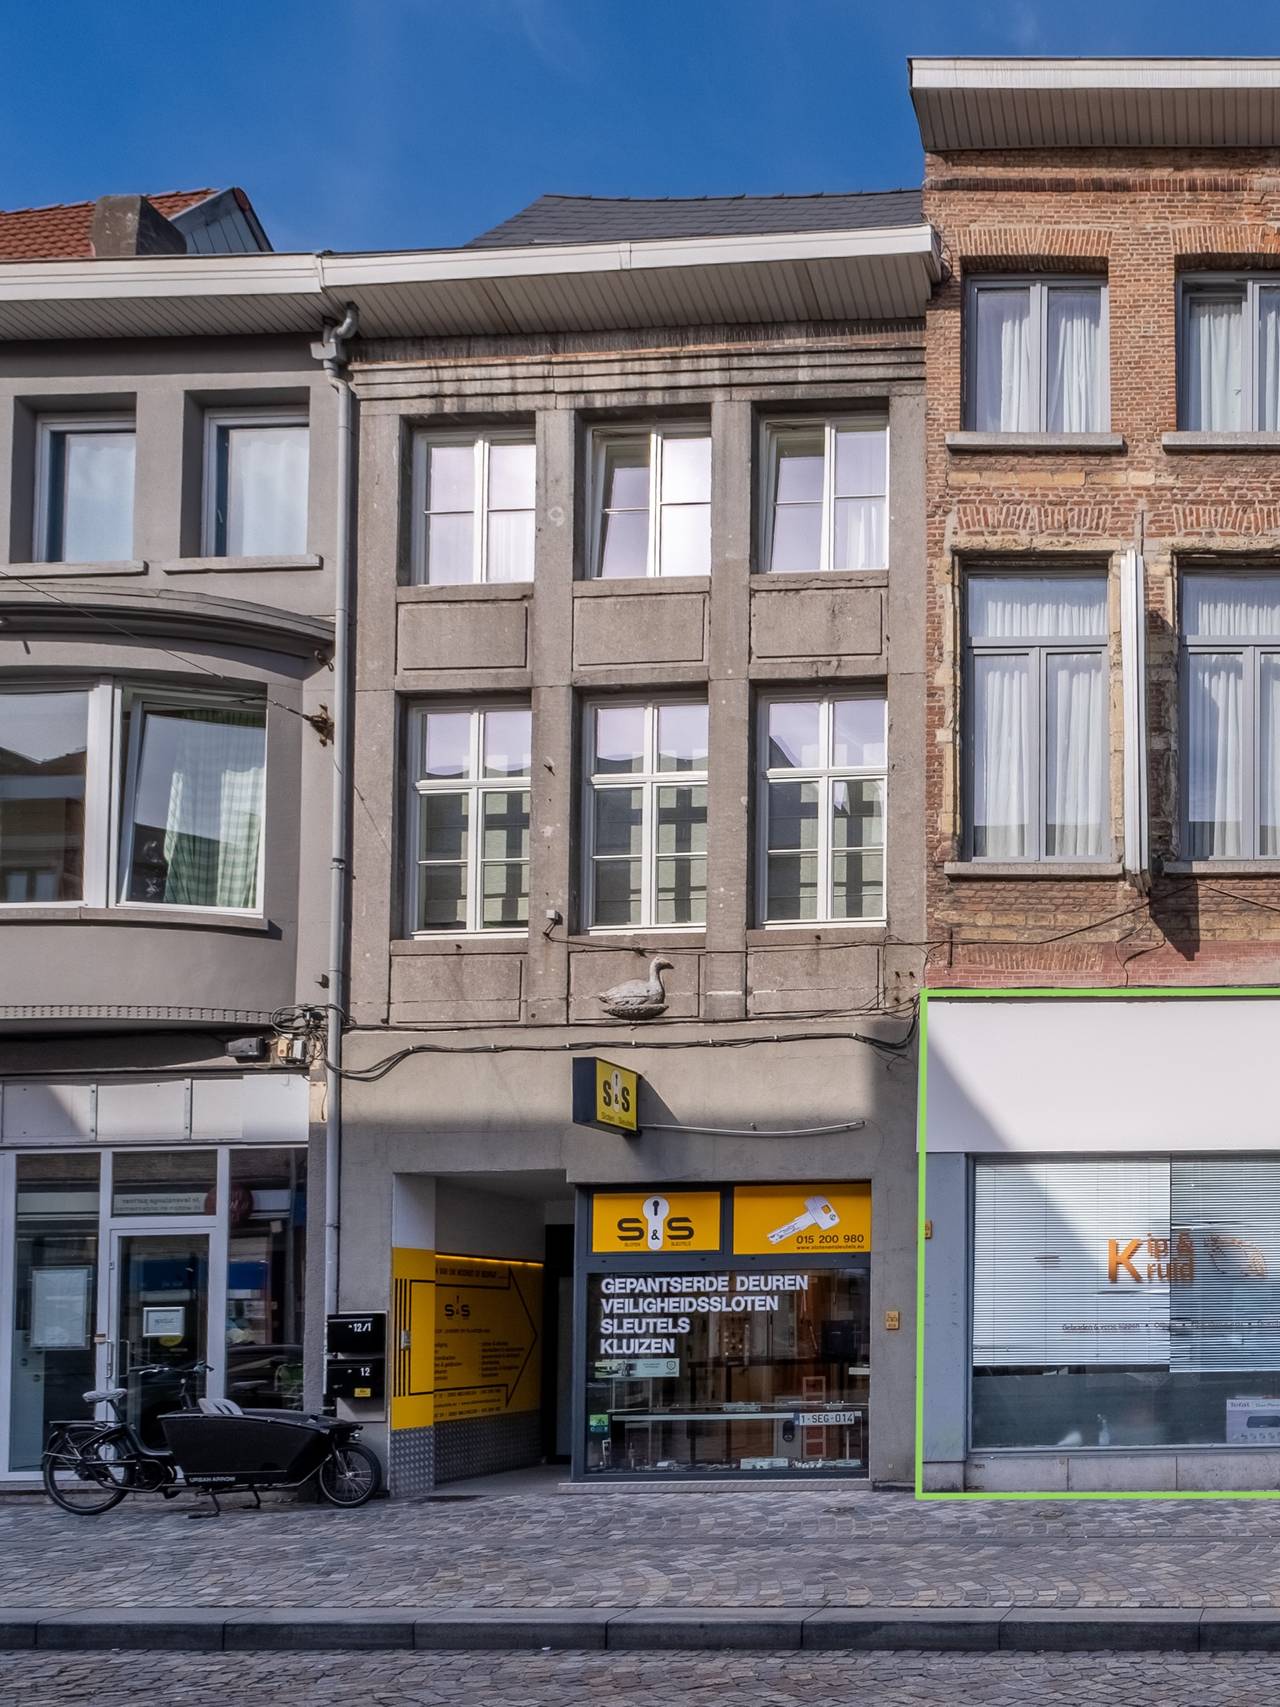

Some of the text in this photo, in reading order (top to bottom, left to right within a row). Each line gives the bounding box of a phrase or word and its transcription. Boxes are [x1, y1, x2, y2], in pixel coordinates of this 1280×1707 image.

[796, 1233, 864, 1245] 015 200 980
[601, 1274, 809, 1294] GEPANTSERDE DEUREN
[600, 1295, 780, 1315] VEILIGHEIDSSLOTEN
[353, 1322, 372, 1332] 12/1
[600, 1316, 691, 1335] SLEUTELS
[600, 1337, 676, 1355] KLUIZEN
[360, 1367, 371, 1377] 12
